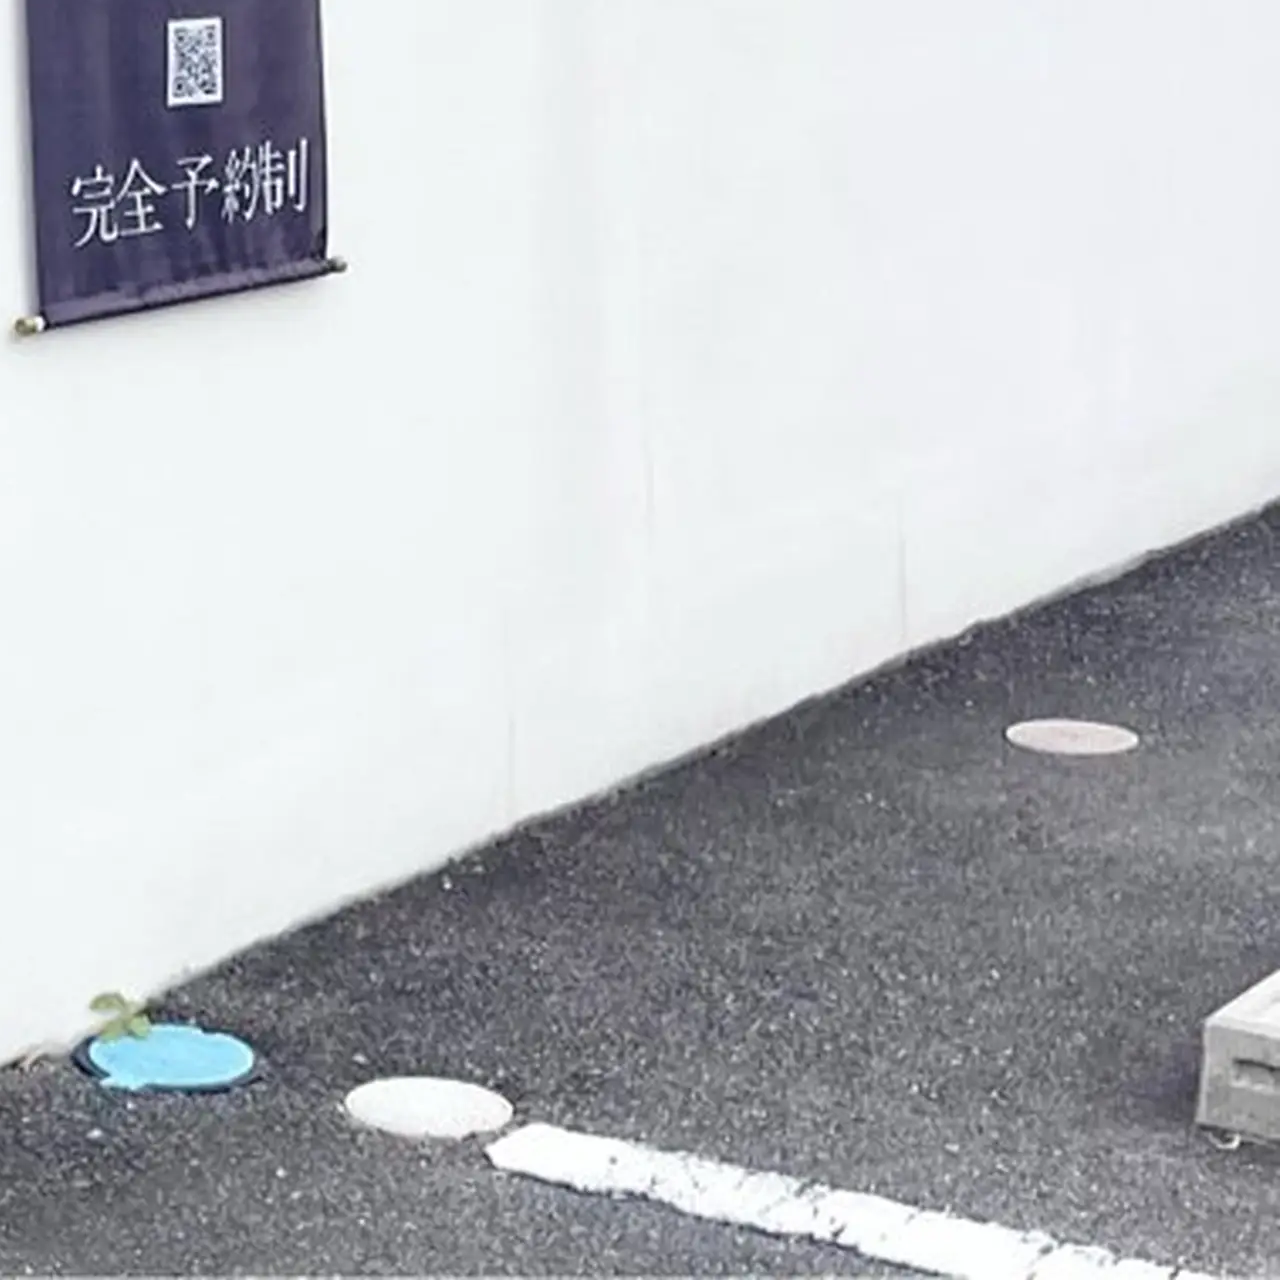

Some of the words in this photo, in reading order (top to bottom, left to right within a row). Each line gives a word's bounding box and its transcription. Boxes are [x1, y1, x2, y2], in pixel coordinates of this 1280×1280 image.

[71, 138, 308, 248] 完全予約制
